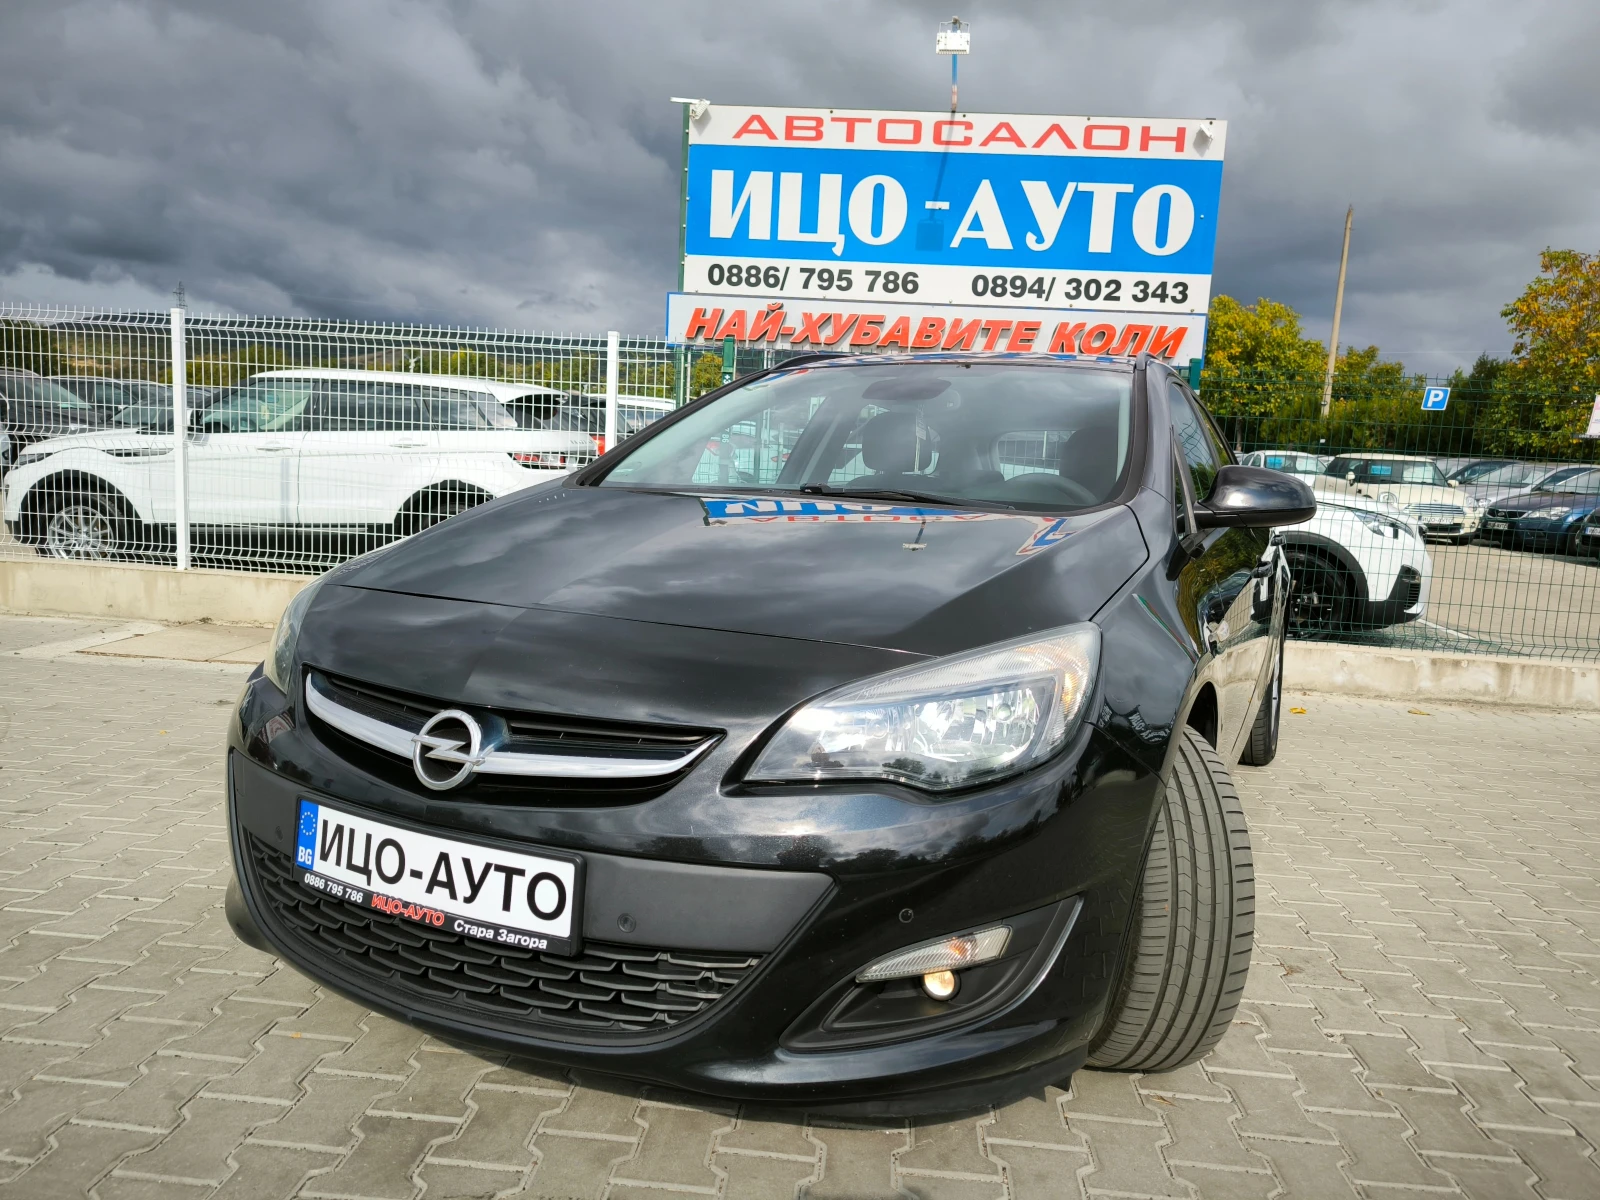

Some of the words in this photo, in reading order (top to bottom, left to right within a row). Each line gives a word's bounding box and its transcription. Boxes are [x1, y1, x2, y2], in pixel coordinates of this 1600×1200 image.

[732, 114, 1186, 153] АВТОСАЛОН
[707, 263, 790, 291] 0886/
[799, 267, 853, 292] 795
[864, 270, 919, 294] 786
[971, 274, 1056, 301] 0894/
[1064, 277, 1122, 302] 302
[1131, 280, 1189, 304] 343
[685, 302, 1042, 352] НАЙ-ХУБАВИТЕ
[1048, 321, 1189, 358] КОЛИ
[1427, 390, 1444, 407] P
[297, 846, 313, 865] BG
[320, 819, 566, 921] ИЦО-АУТО
[304, 873, 325, 889] 0886
[326, 881, 343, 897] 795
[345, 888, 363, 903] 786
[371, 894, 445, 926] ИЦО-АУТО
[454, 919, 494, 939] Стара
[497, 928, 548, 949] Загора
